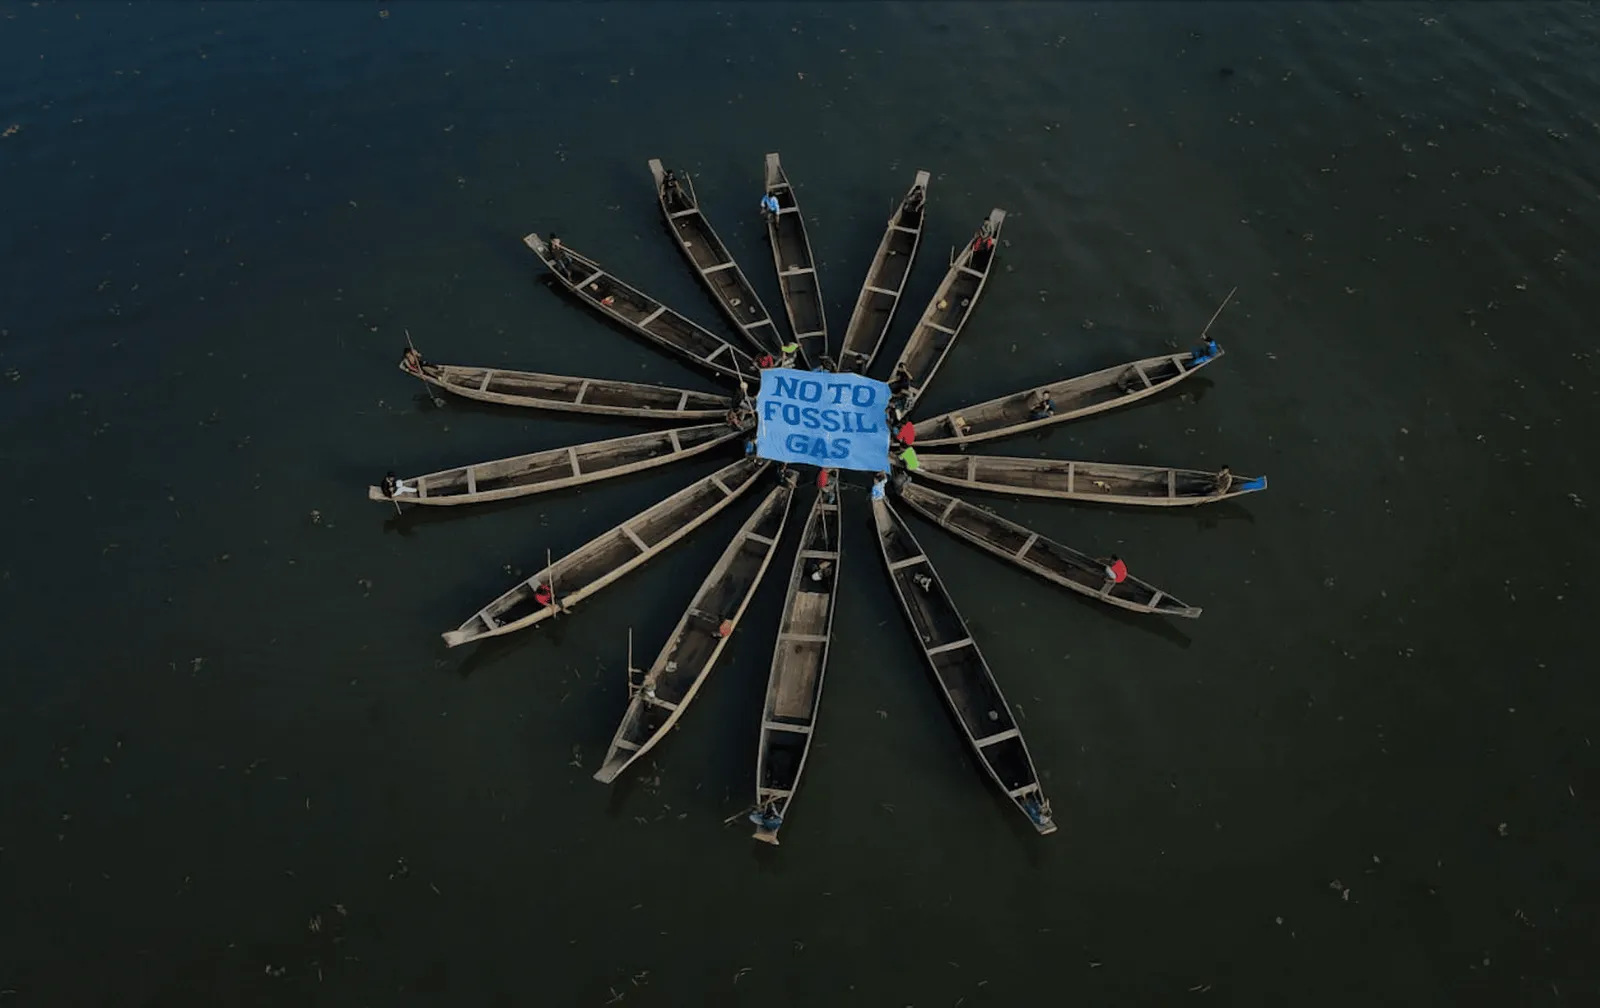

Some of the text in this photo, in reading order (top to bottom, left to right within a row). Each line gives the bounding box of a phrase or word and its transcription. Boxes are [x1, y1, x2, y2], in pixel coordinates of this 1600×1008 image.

[771, 376, 876, 407] NO TO
[764, 400, 878, 433] FOSSIL
[785, 433, 851, 459] GAS
